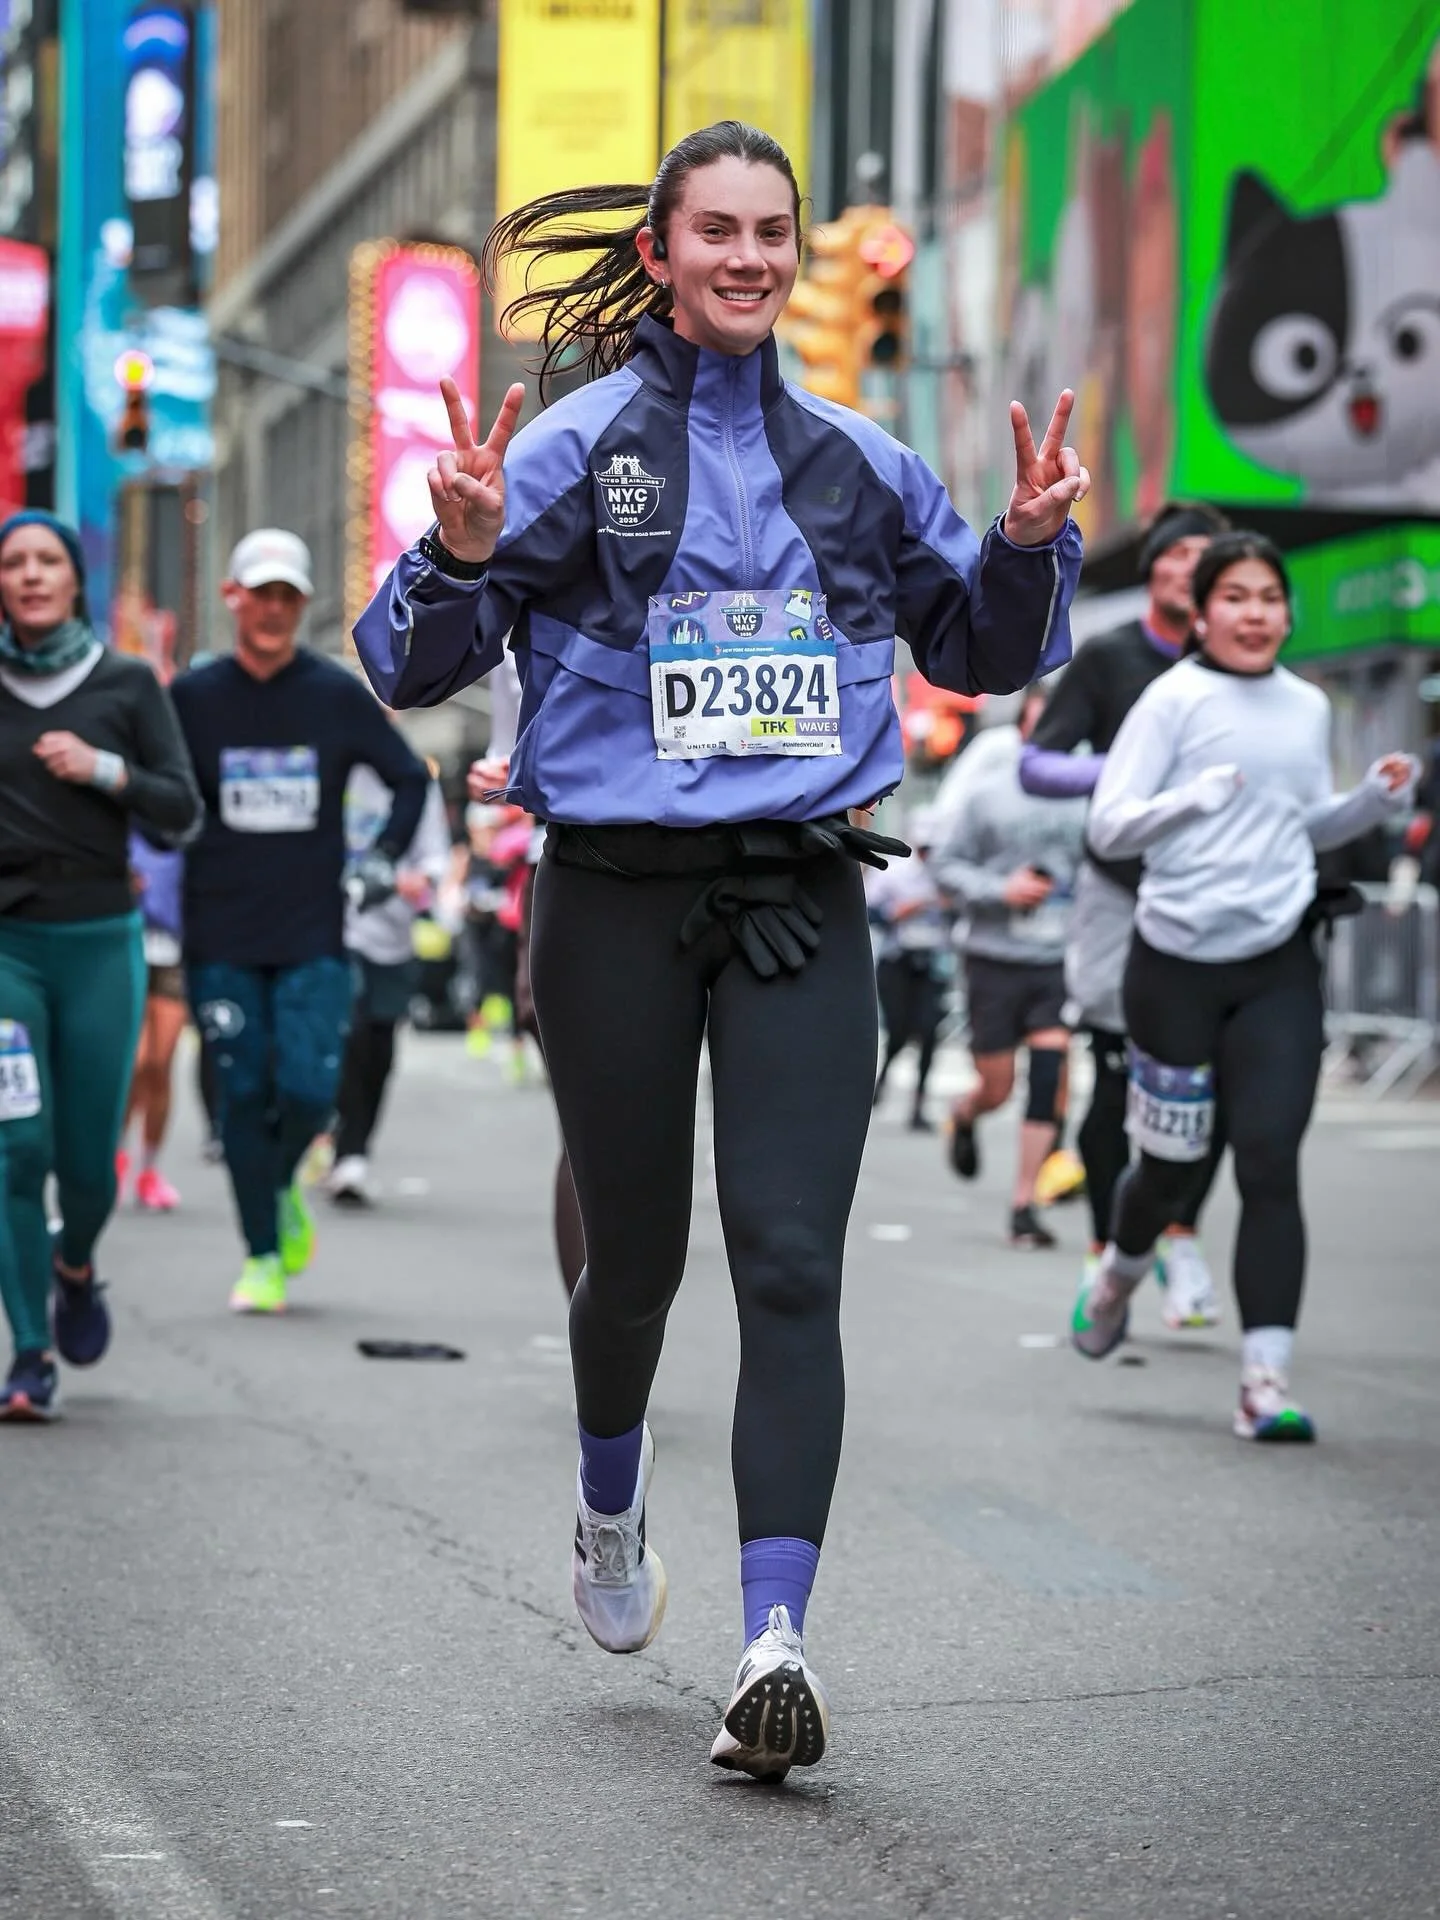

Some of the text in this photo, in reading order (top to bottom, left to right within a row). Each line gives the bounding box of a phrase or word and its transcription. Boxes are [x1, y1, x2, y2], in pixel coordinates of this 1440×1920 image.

[608, 488, 648, 502] NYC
[612, 504, 645, 514] HALF
[733, 614, 757, 624] NYC
[760, 721, 838, 733] TFK WAVE 3
